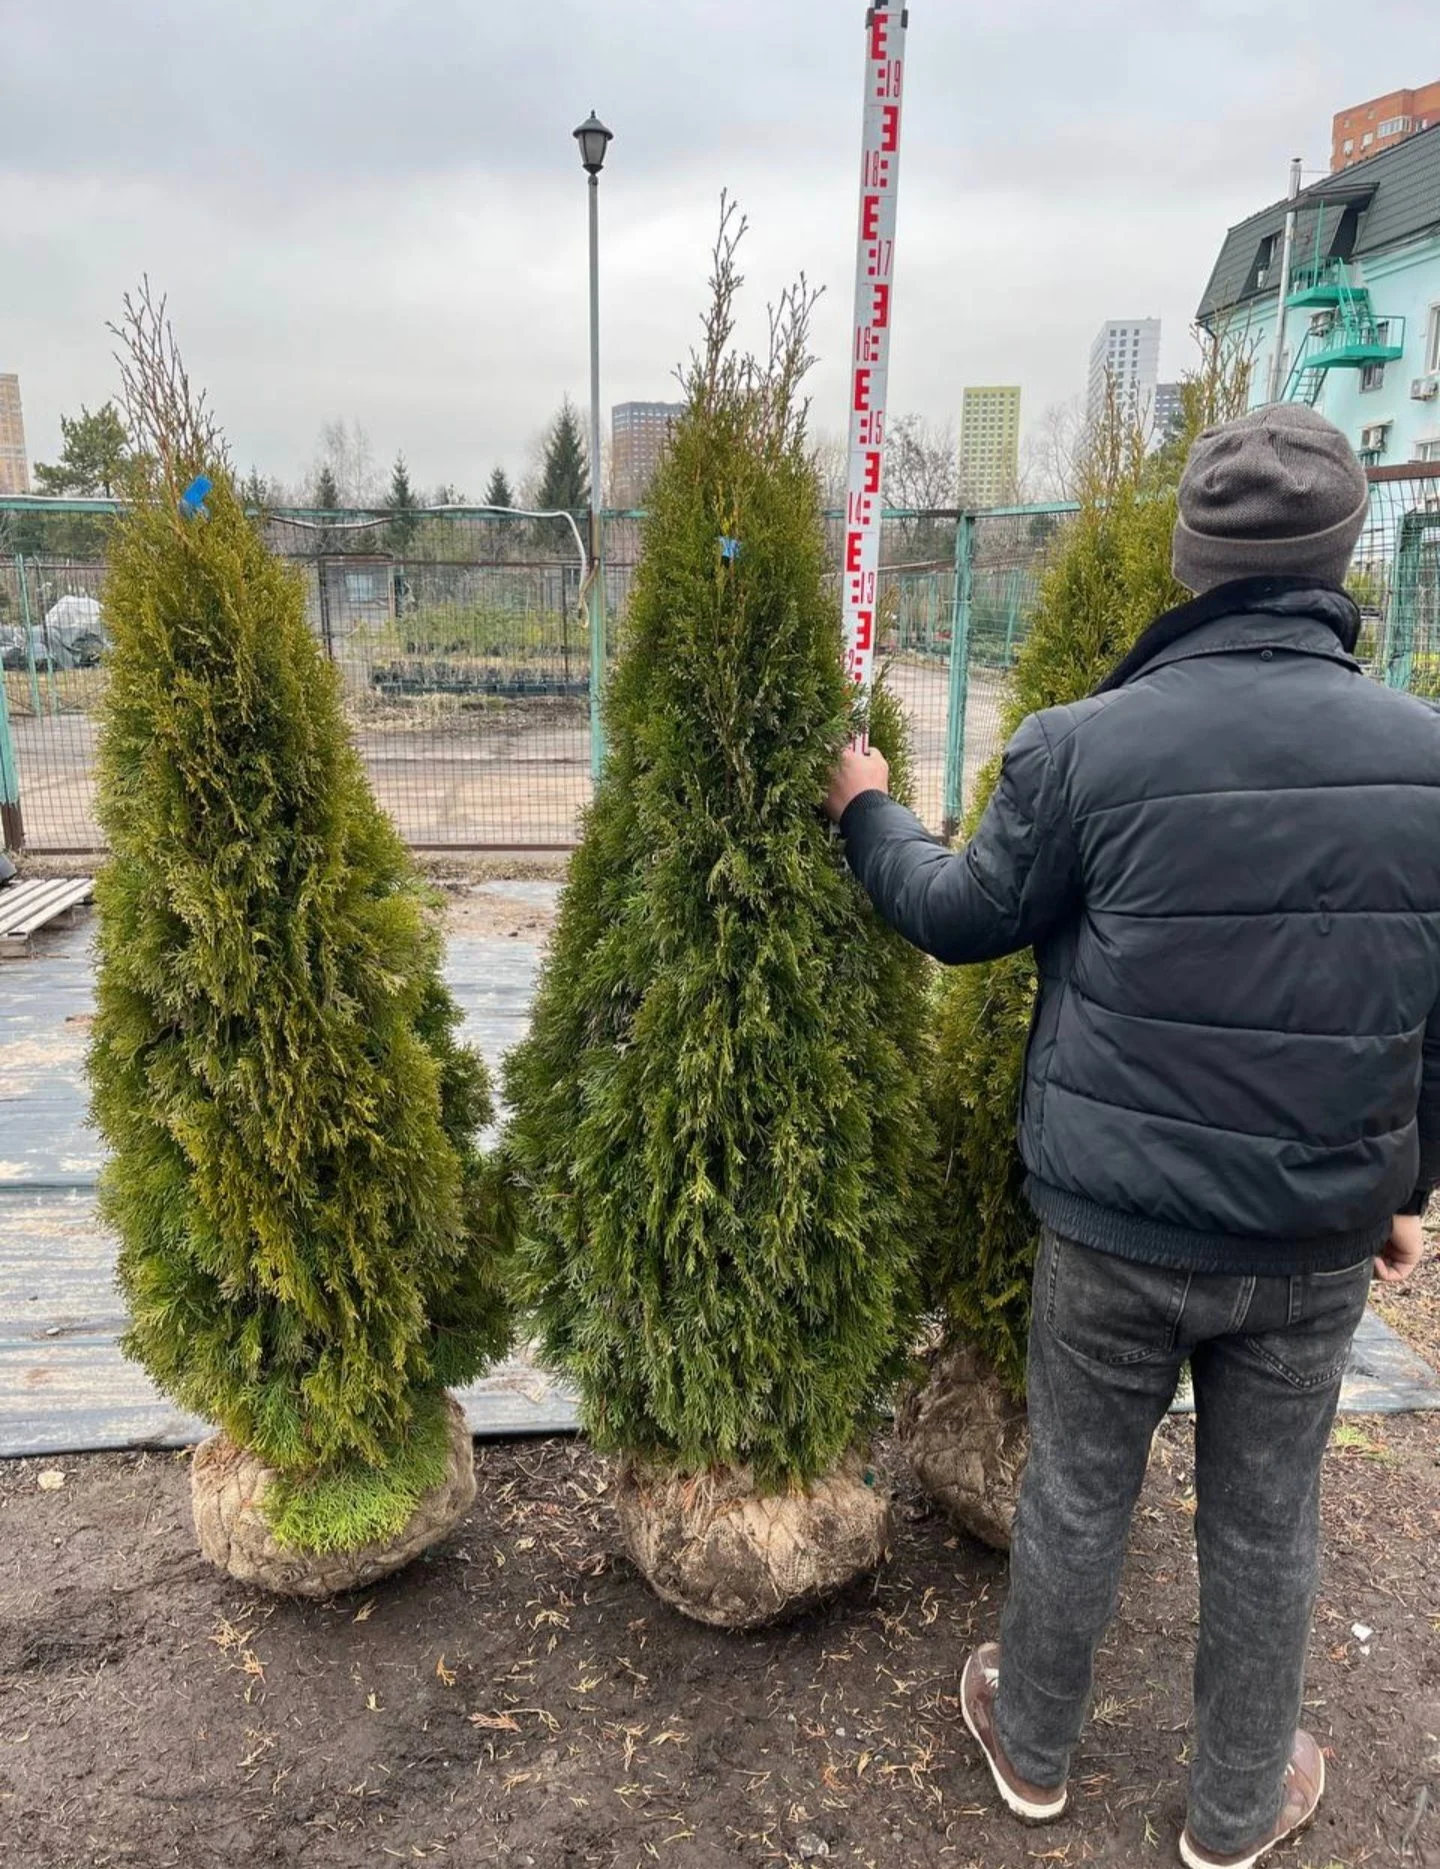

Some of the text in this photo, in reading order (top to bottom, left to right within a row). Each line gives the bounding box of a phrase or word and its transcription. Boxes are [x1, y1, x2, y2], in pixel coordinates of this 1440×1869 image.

[886, 60, 901, 97] 19
[864, 150, 879, 187] 18
[877, 240, 891, 276] 17
[856, 325, 870, 361] 16
[868, 411, 882, 444] 15
[848, 491, 861, 525] 14
[860, 571, 874, 604] 13
